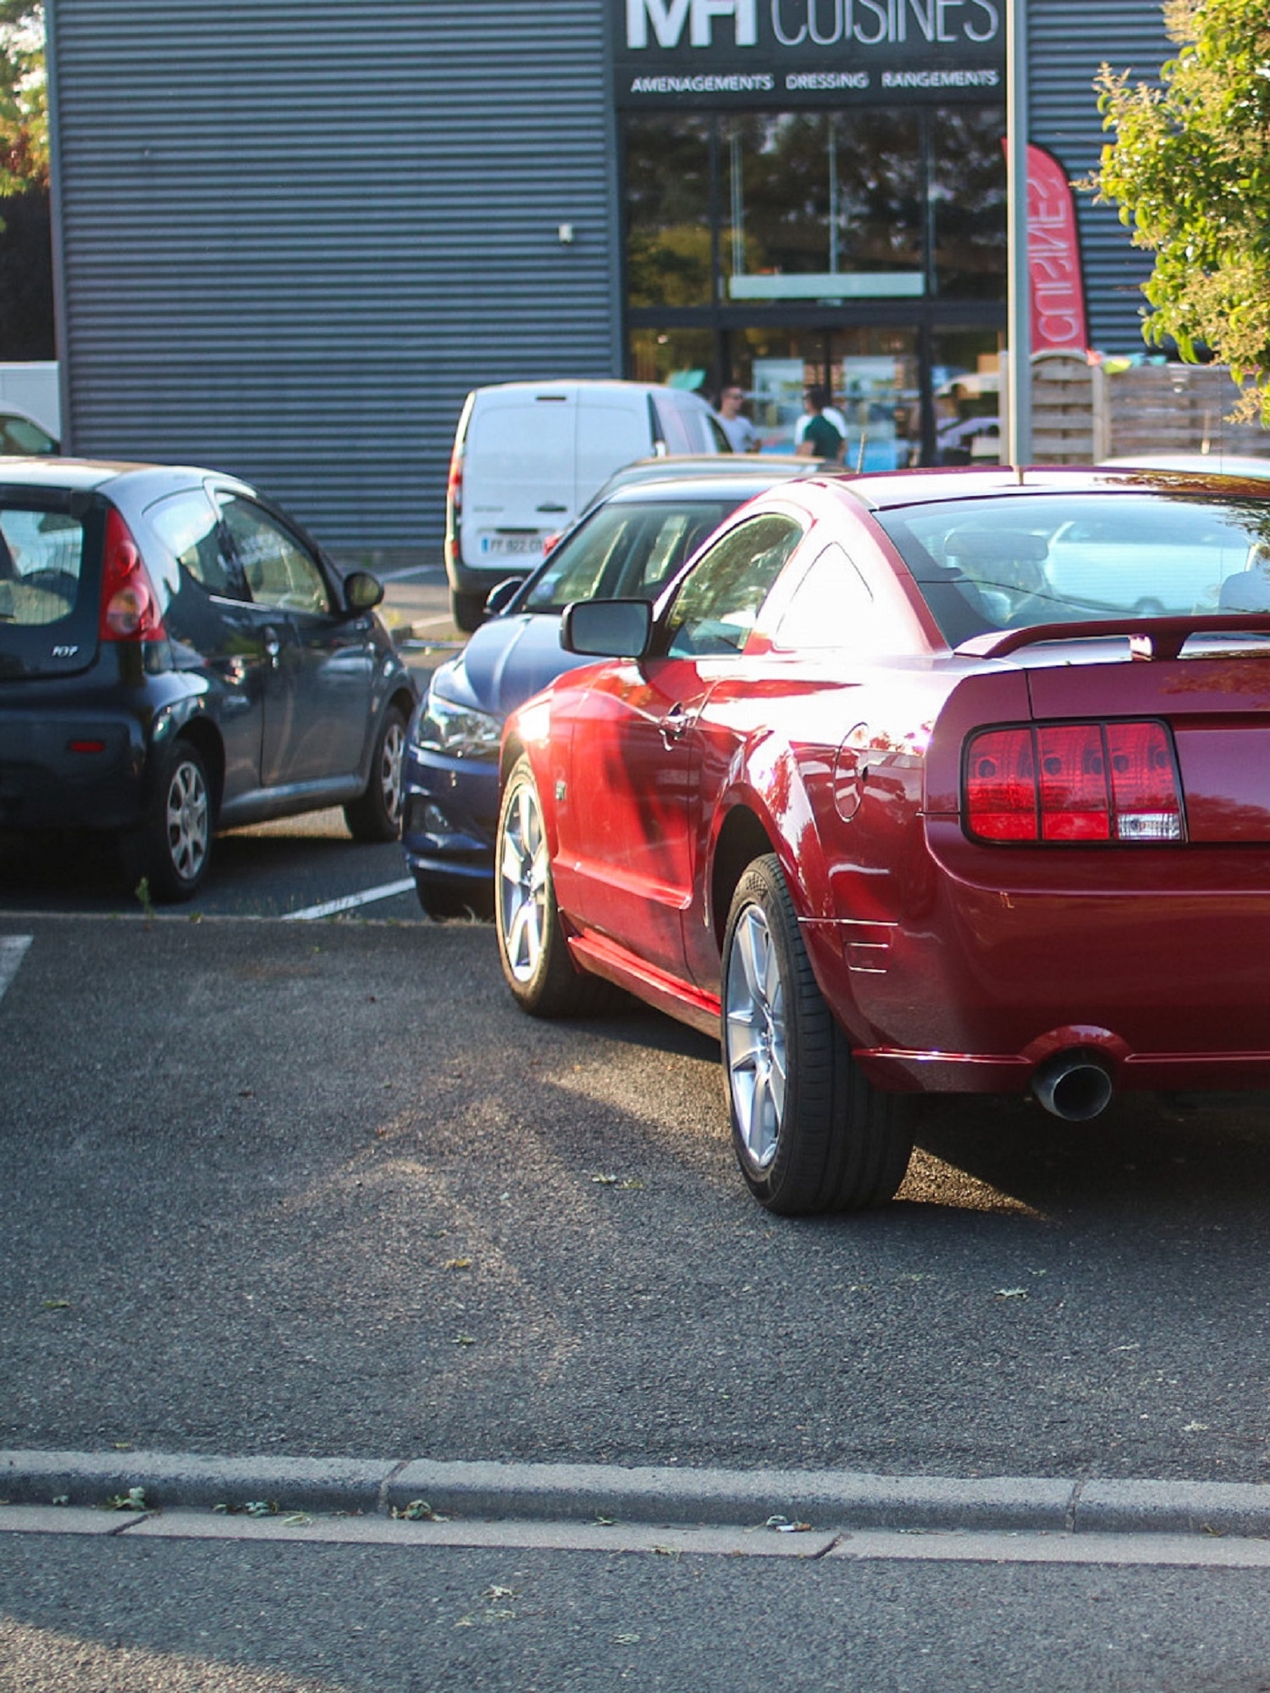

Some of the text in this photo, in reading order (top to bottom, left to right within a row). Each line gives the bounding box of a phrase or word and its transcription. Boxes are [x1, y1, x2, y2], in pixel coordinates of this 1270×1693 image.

[771, 0, 1000, 45] CUISINES
[630, 69, 1001, 93] AMENAGEMENTS DRESSING RANGEMENTS
